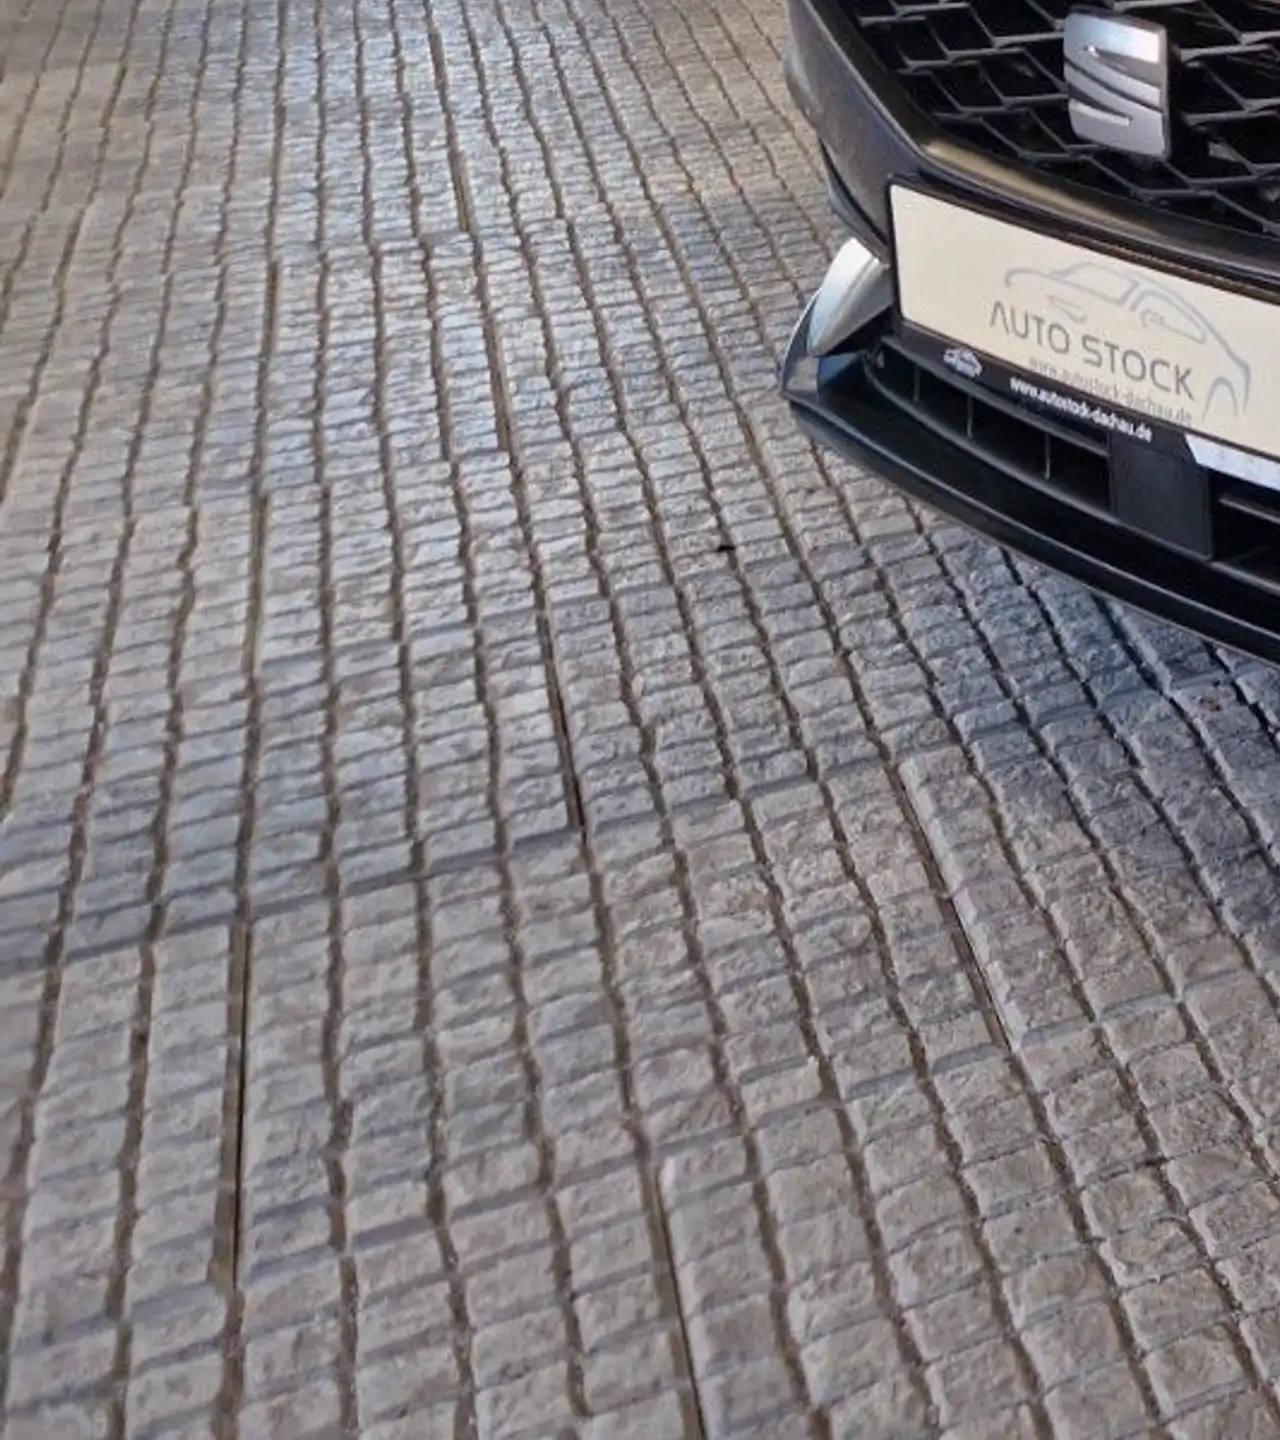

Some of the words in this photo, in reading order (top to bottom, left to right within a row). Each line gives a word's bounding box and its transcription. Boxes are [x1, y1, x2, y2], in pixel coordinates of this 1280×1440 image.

[989, 300, 1071, 355] AUTO
[1081, 333, 1194, 401] STOCK
[1009, 375, 1153, 444] www.autostock-dachau.de
[1027, 355, 1194, 428] www.autostock-dachau.de
